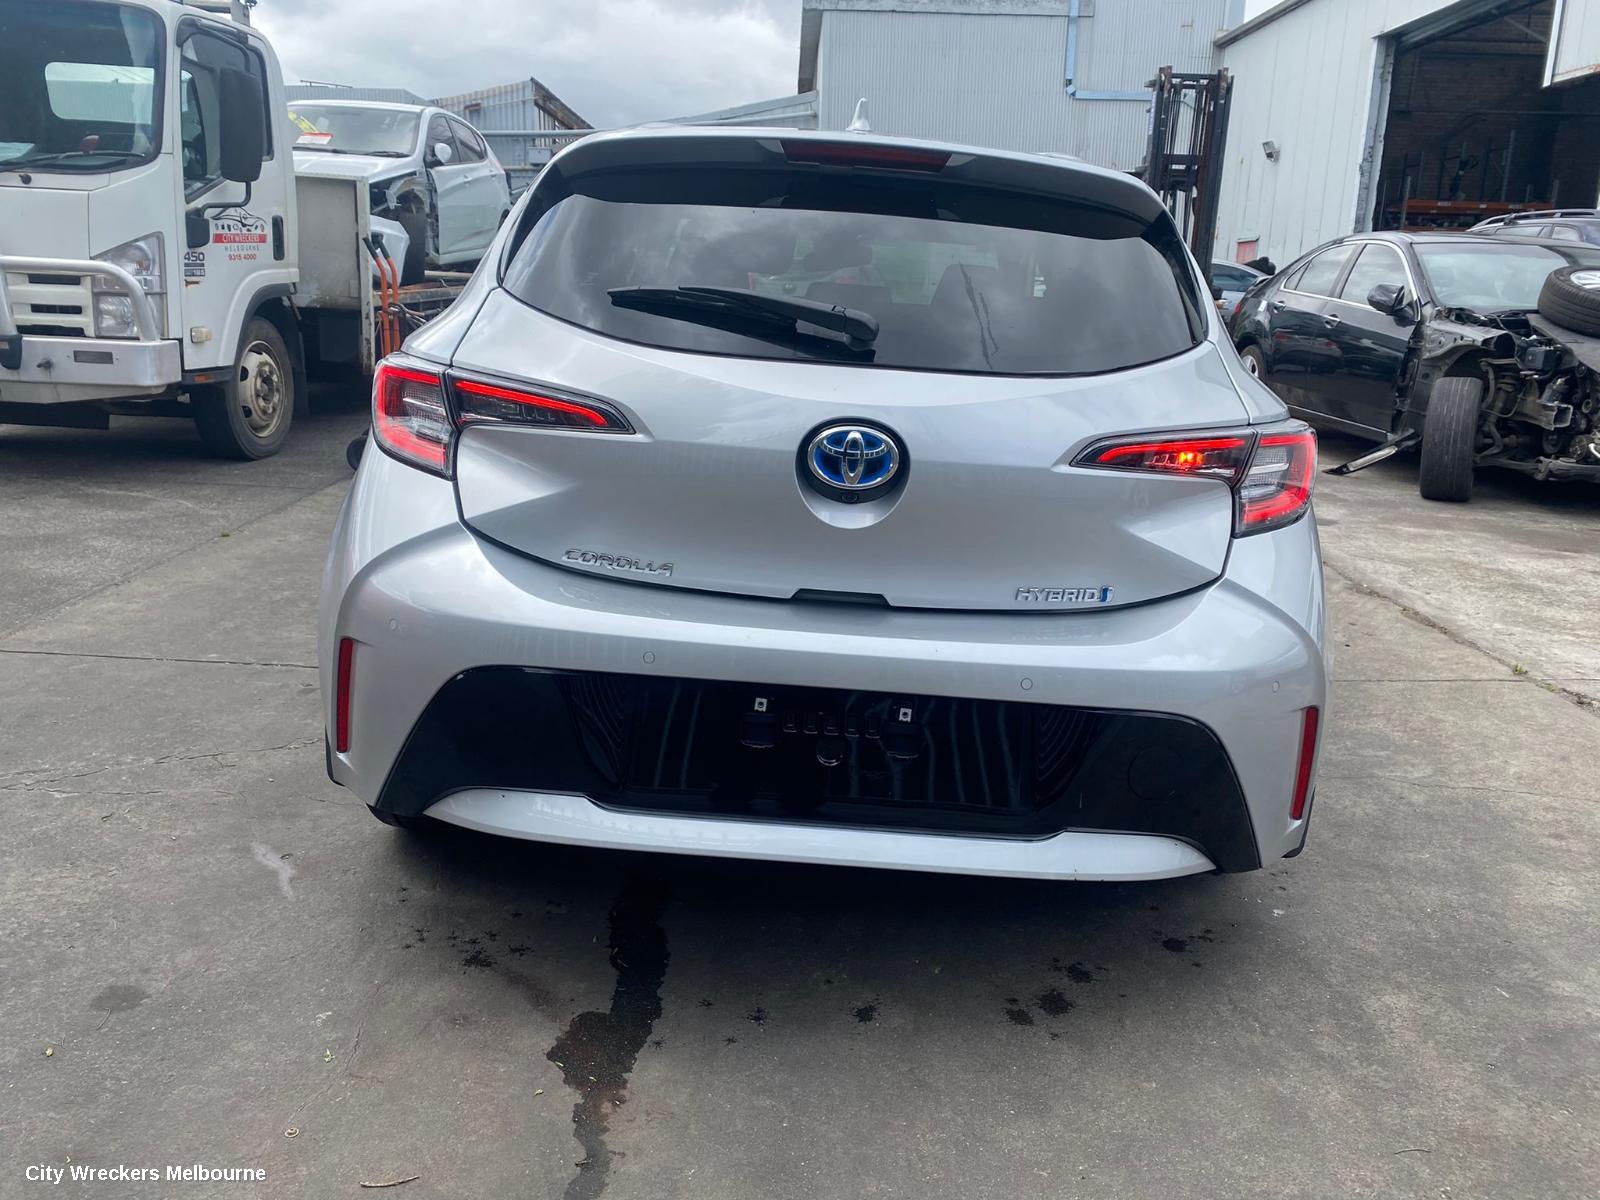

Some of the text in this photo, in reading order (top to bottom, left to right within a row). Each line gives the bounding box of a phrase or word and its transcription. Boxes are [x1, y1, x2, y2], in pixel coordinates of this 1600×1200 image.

[184, 251, 205, 261] 450
[562, 548, 674, 577] COROLLA
[1015, 586, 1099, 602] HYBRID
